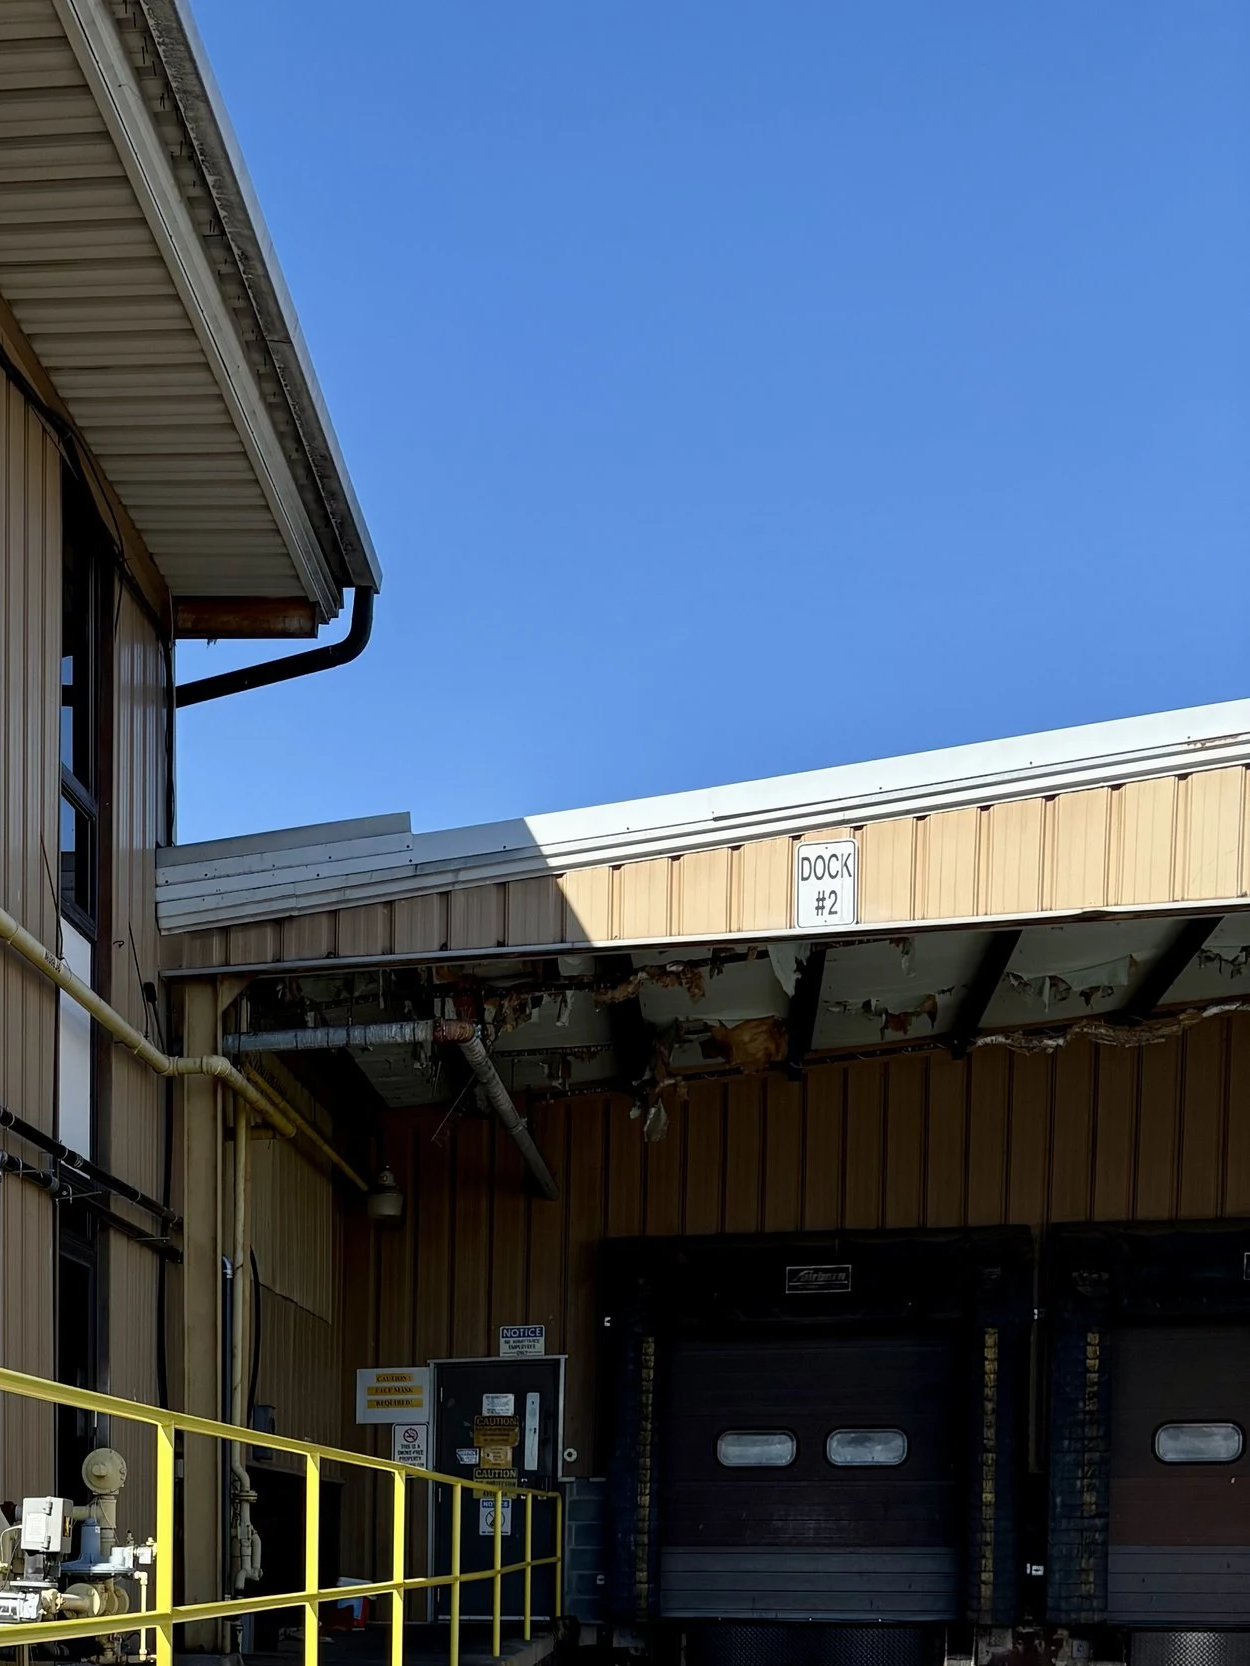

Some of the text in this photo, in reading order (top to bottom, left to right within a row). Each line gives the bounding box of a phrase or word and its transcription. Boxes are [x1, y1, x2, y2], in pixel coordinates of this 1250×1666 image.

[800, 852, 853, 882] DOCK
[814, 889, 839, 917] #2
[503, 1328, 542, 1337] NOTICE
[476, 1416, 517, 1426] CAUTION
[475, 1468, 517, 1478] CAUTION
